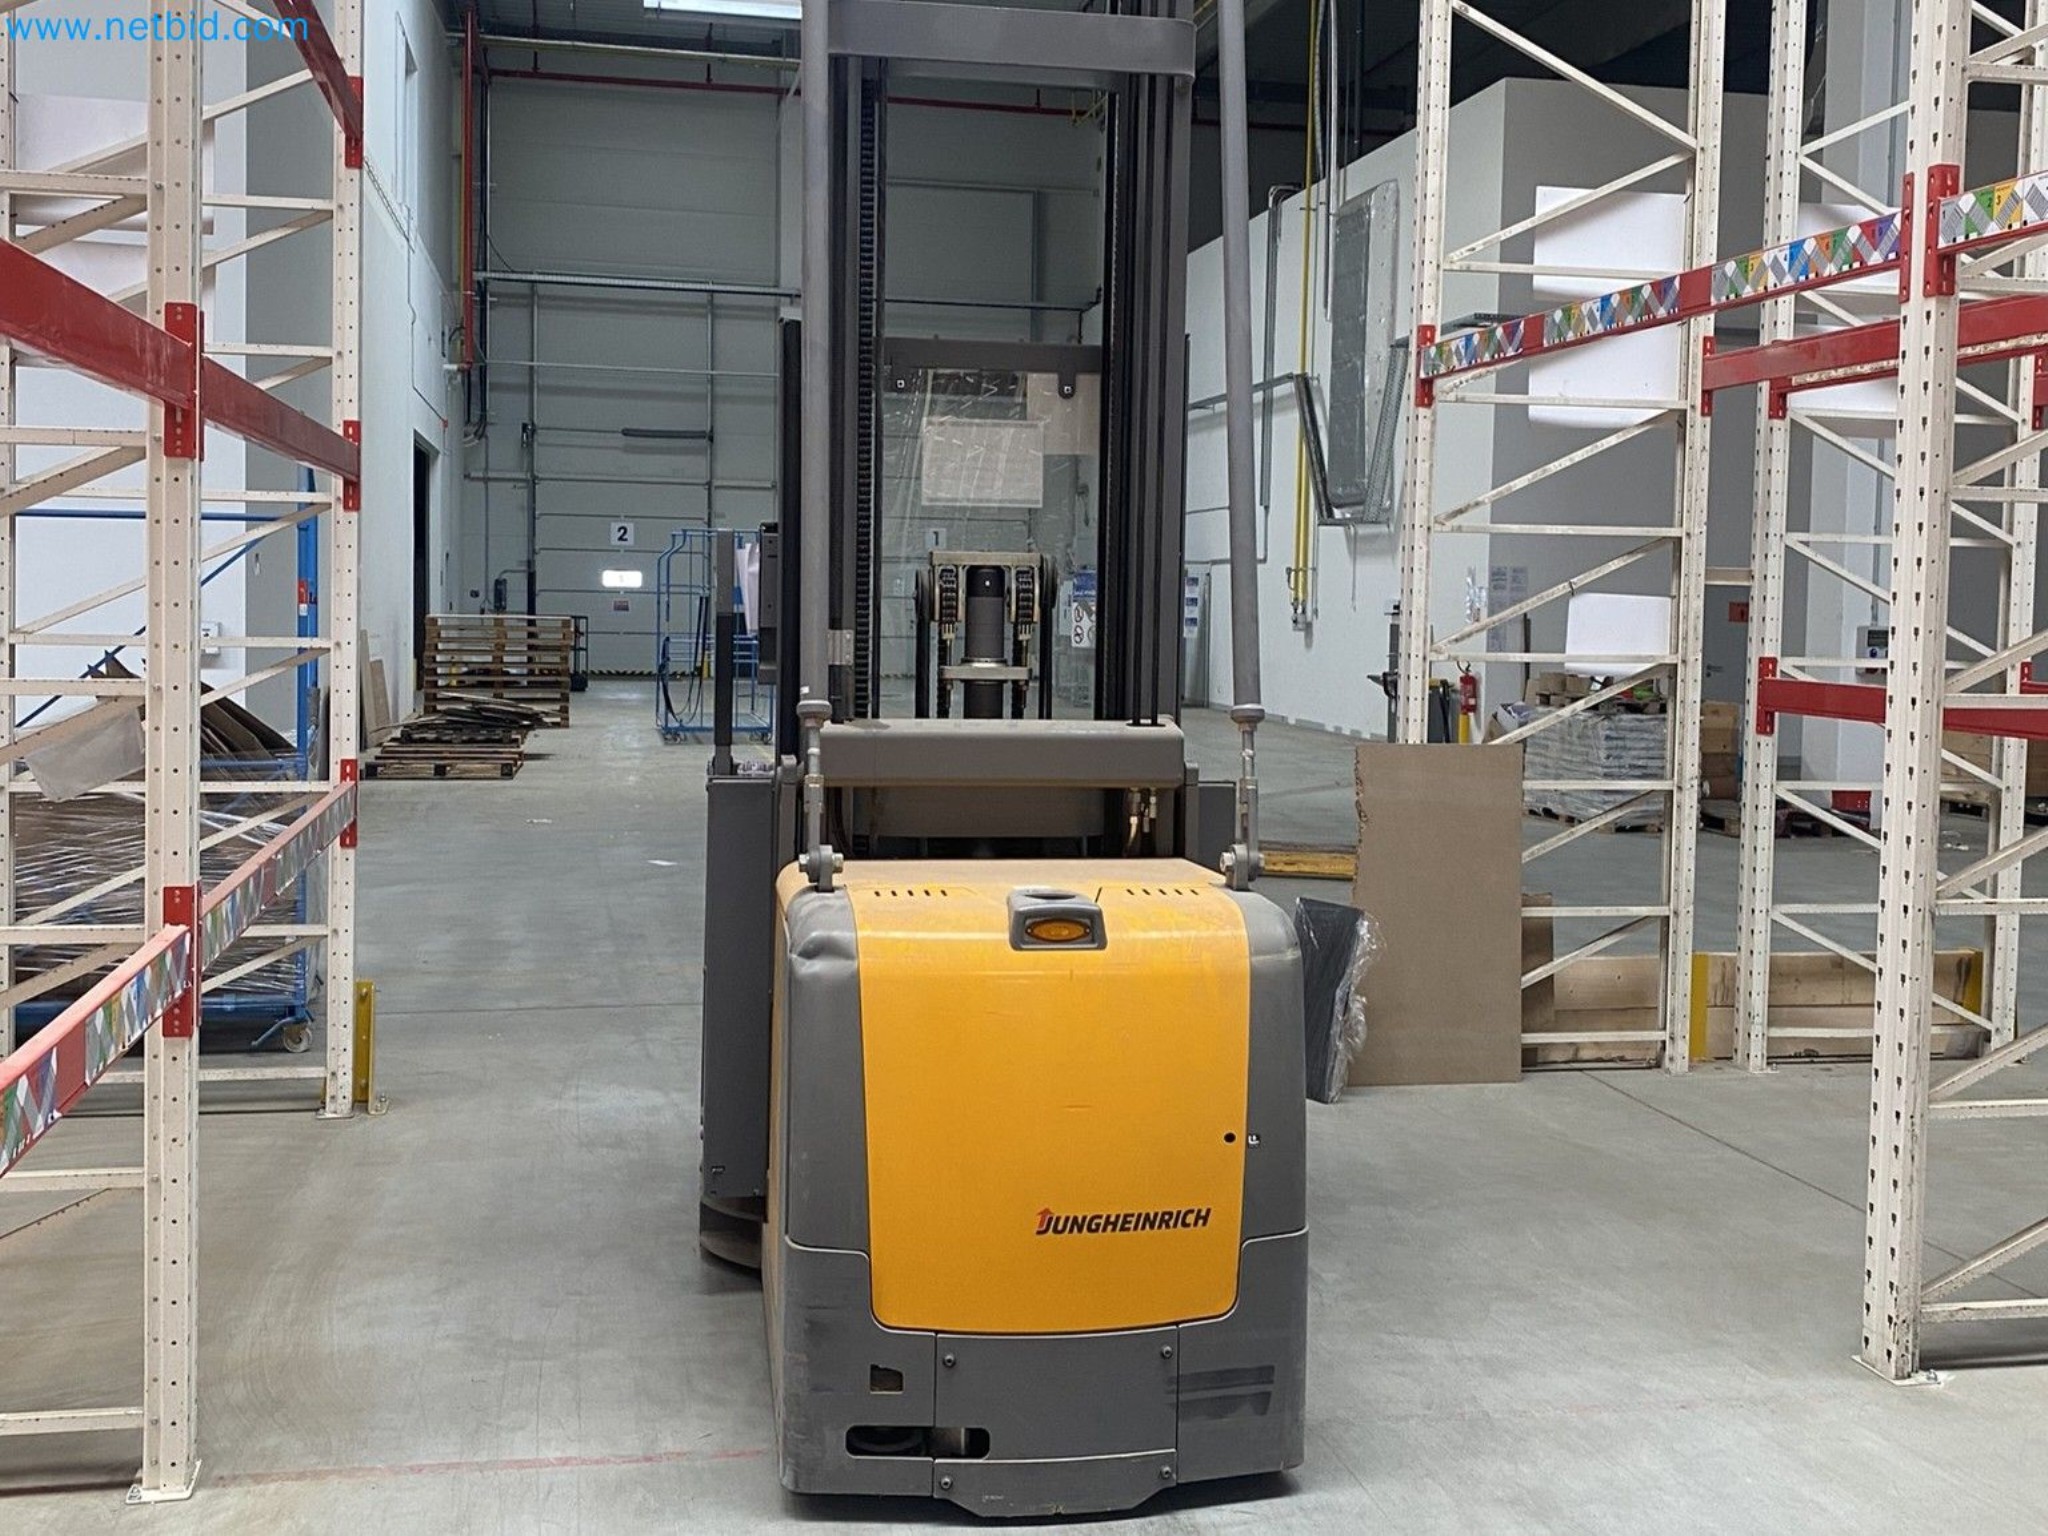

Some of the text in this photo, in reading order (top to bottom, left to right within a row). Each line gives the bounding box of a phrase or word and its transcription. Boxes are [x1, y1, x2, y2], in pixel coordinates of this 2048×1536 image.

[617, 526, 628, 541] 2
[932, 531, 939, 546] 1
[1036, 1207, 1212, 1236] JUNGHEINRICH
